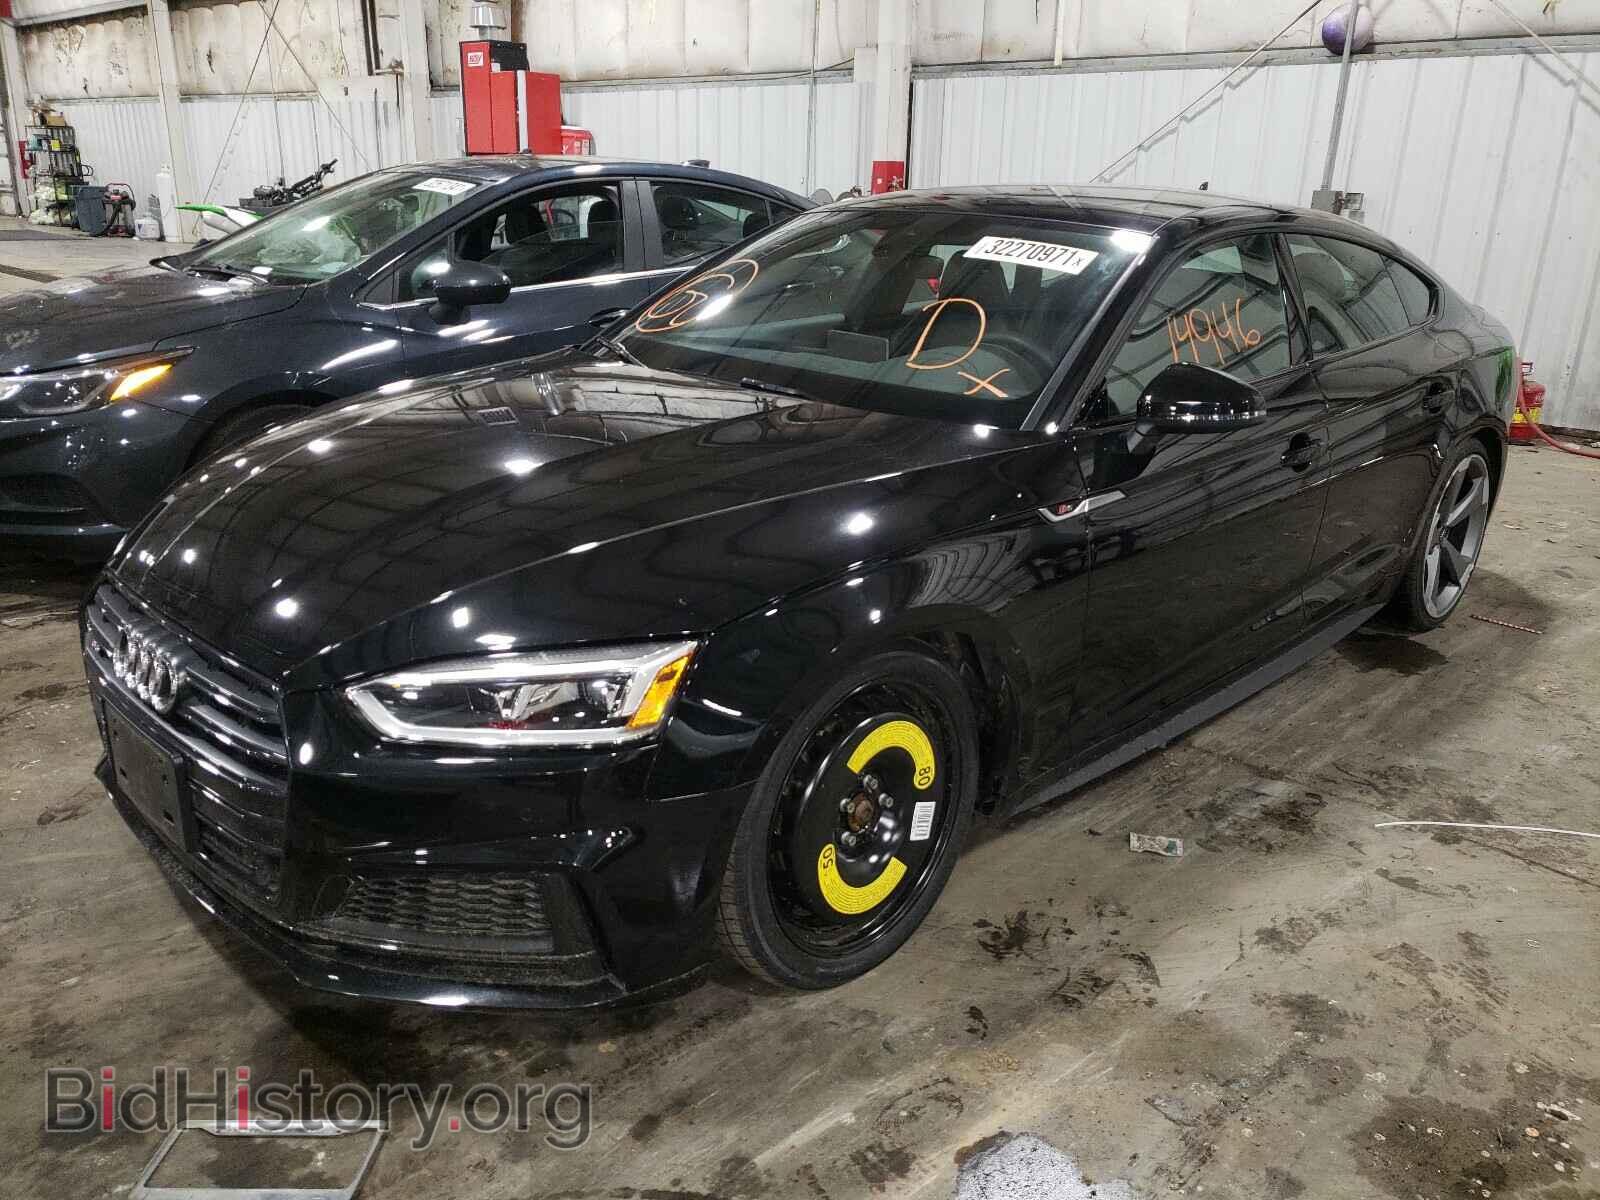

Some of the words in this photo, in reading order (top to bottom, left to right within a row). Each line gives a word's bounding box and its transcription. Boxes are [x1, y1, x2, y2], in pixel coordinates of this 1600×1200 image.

[905, 297, 987, 370] D
[918, 766, 932, 786] 80
[822, 847, 834, 869] 50
